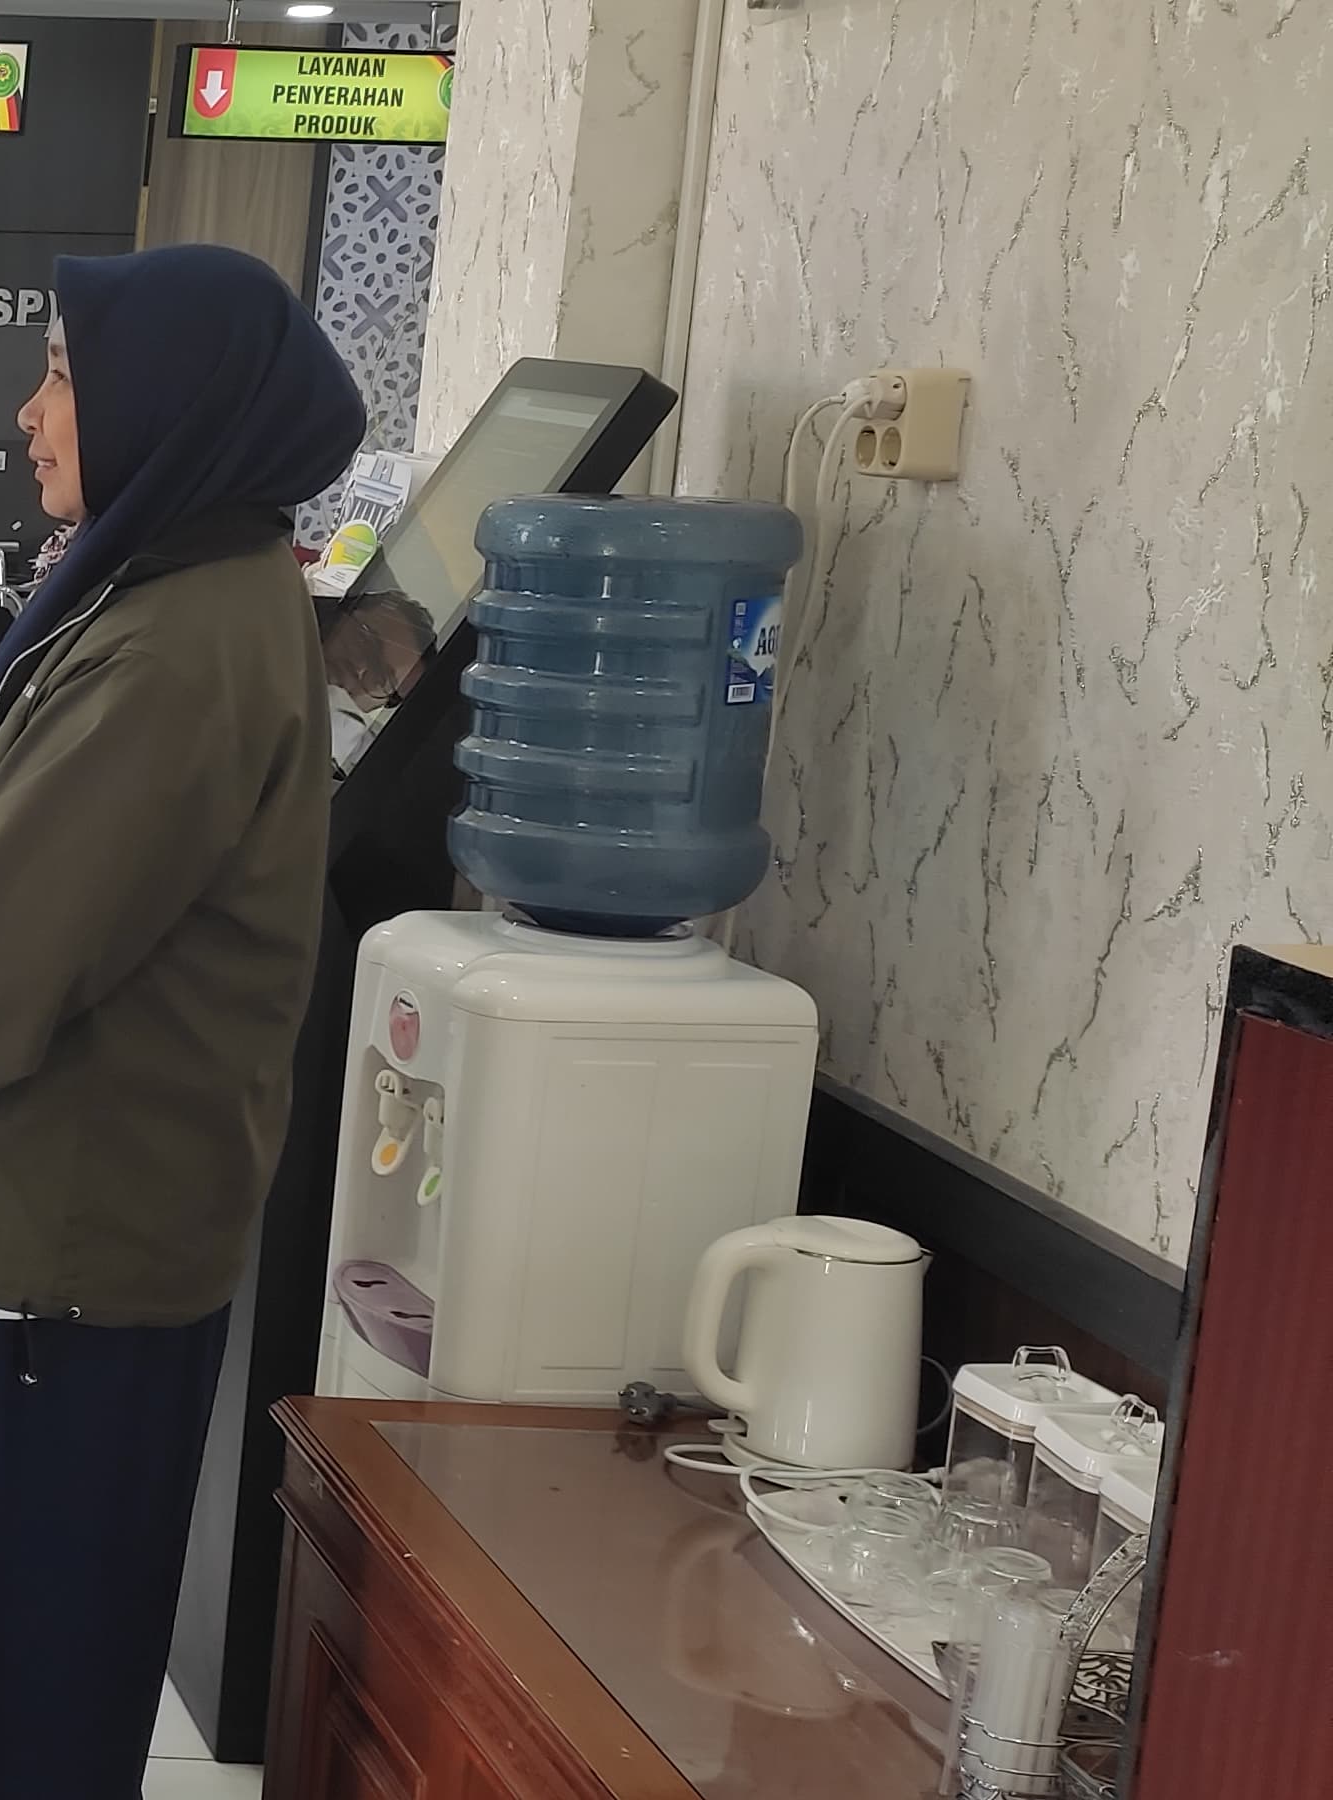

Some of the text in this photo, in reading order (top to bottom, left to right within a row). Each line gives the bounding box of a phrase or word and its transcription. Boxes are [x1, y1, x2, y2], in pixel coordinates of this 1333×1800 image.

[298, 56, 386, 77] LAYANAN
[273, 84, 404, 107] PENYERAHAN
[294, 114, 376, 135] PRODUK
